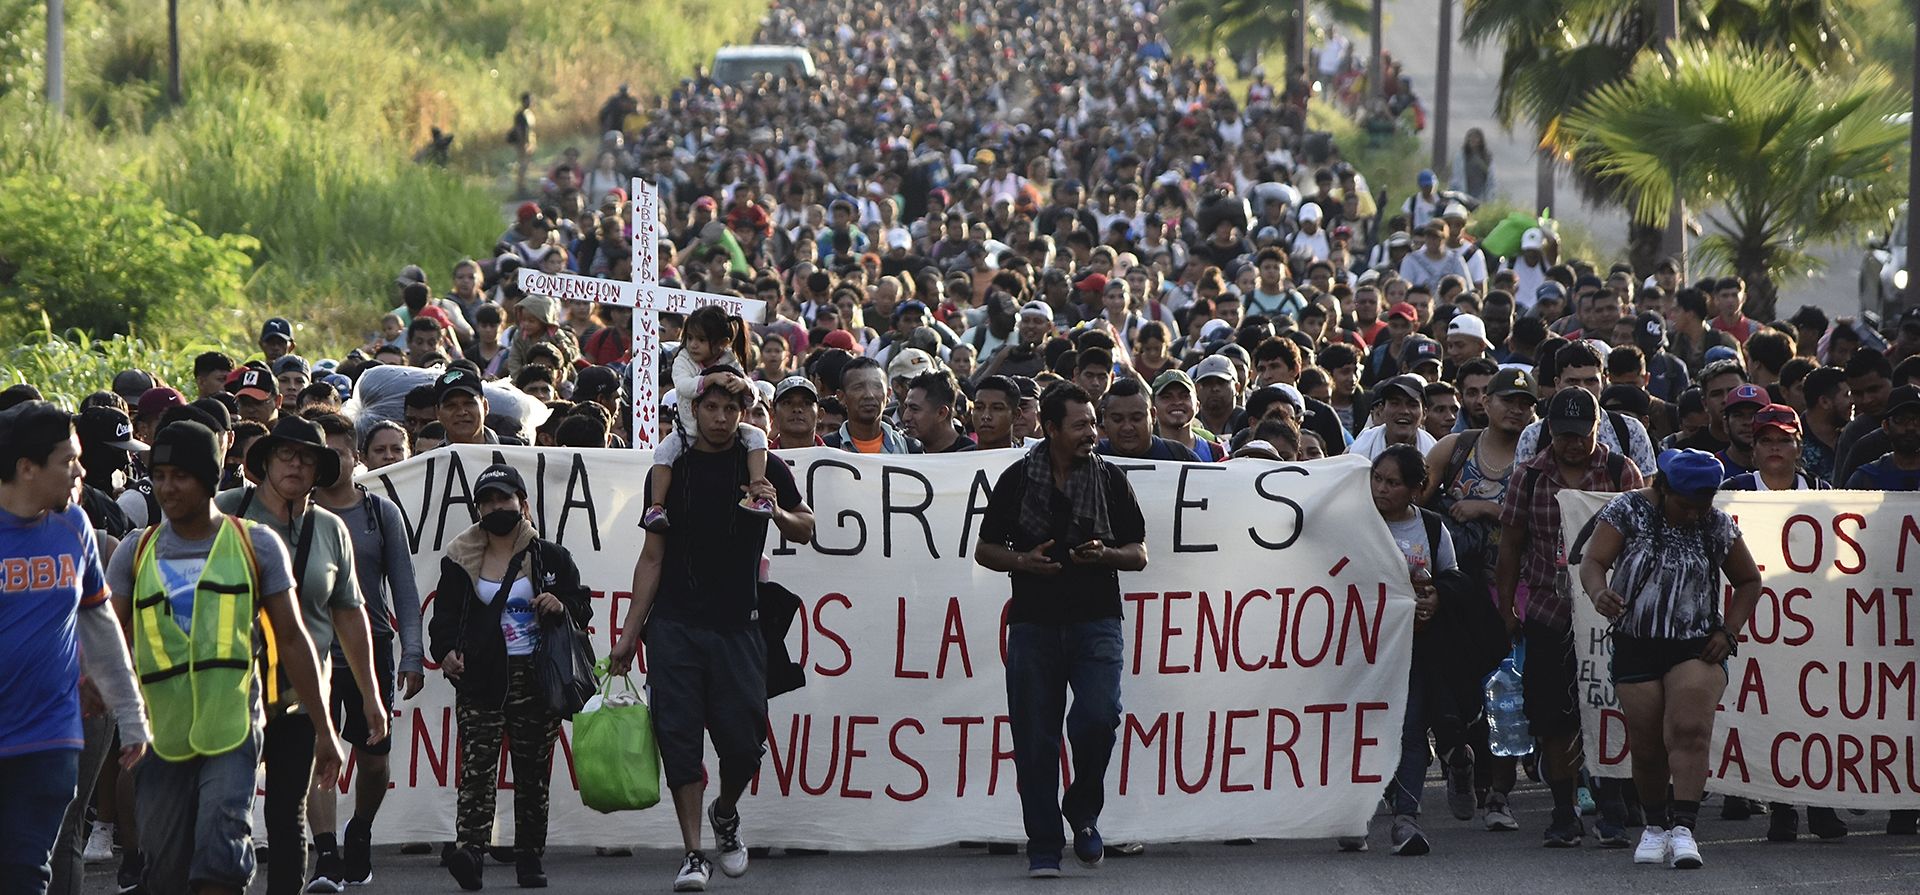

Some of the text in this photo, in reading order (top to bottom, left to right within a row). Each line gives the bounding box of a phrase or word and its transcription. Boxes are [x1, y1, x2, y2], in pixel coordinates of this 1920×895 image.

[525, 274, 621, 299] CONTENCION
[636, 289, 654, 303] ES
[640, 180, 652, 385] LIBERTAD VIDA
[772, 459, 1309, 558] GRAES
[1732, 512, 1867, 575] OS
[0, 554, 77, 593] BBA
[895, 597, 973, 678] LA
[1000, 557, 1386, 674] TENCIÓN
[1579, 660, 1602, 682] EL
[1715, 658, 1769, 714] A
[751, 702, 1389, 803] NUESTR MUERTE
[1705, 727, 1751, 783] A
